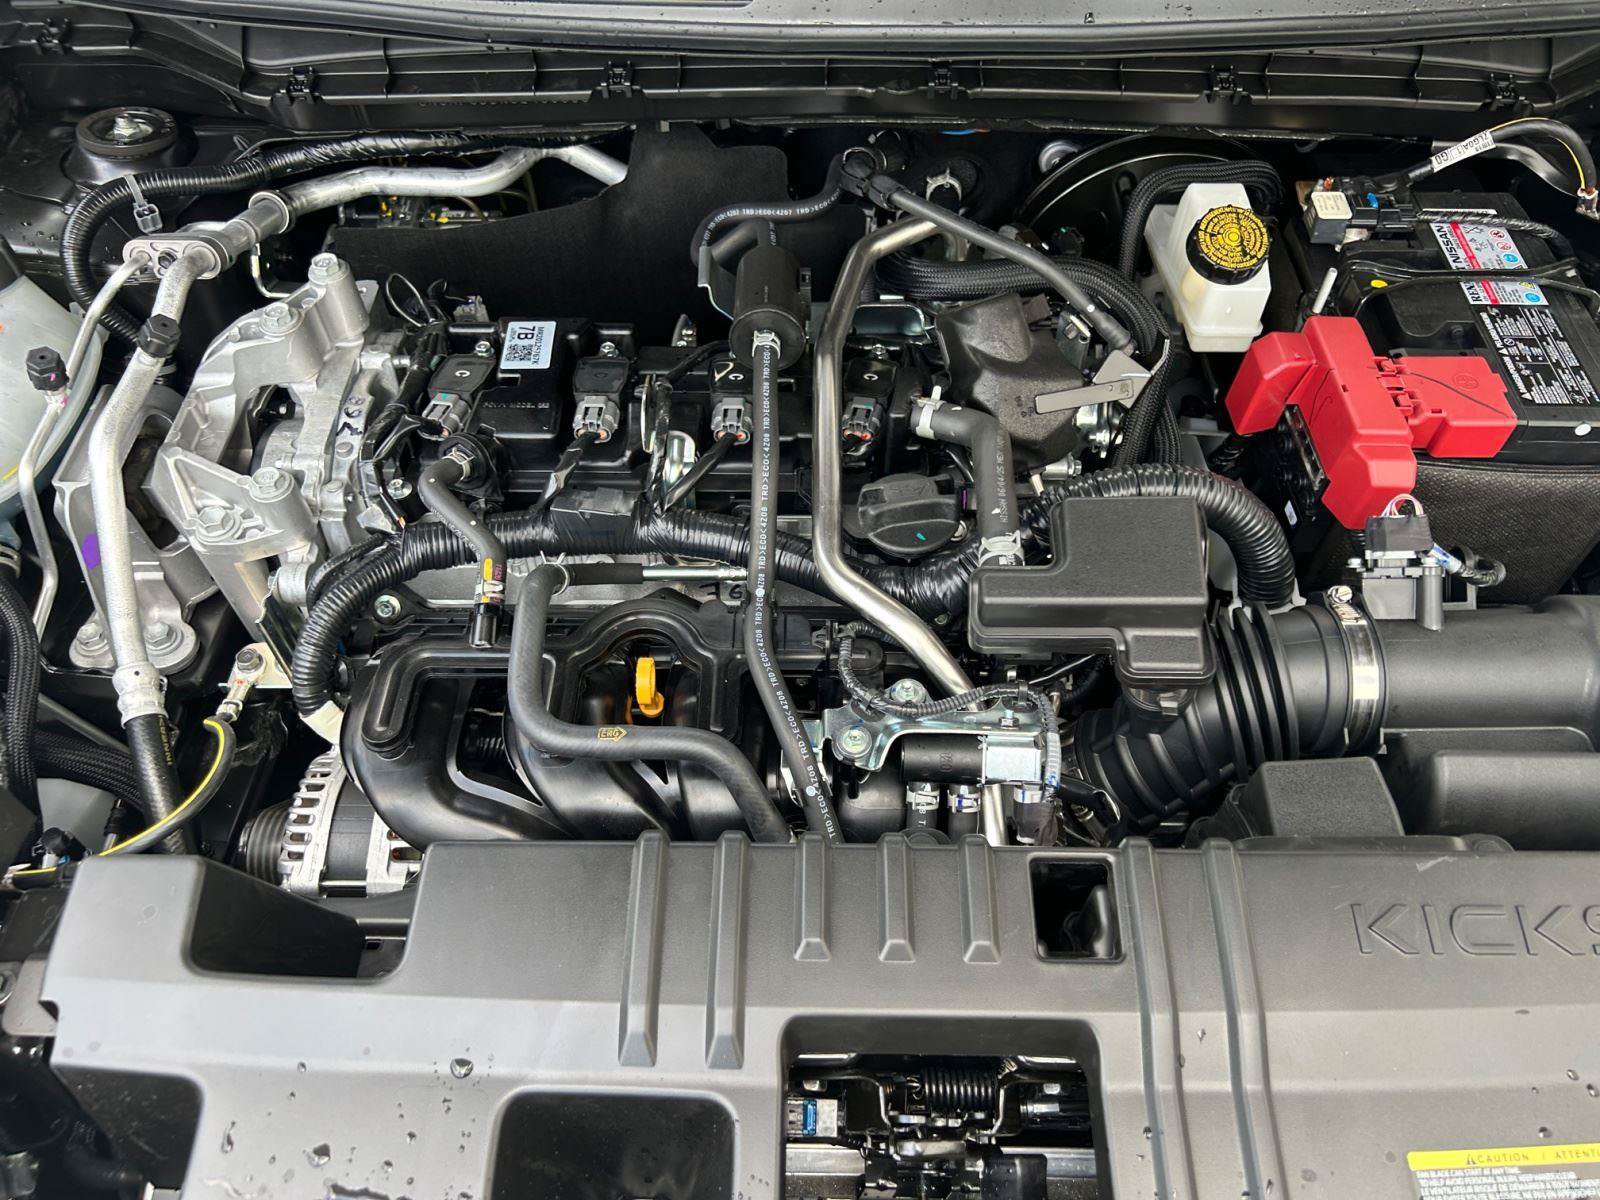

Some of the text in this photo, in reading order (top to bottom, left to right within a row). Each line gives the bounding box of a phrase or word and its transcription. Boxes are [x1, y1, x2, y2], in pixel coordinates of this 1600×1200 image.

[1435, 225, 1462, 264] NISSAN
[517, 326, 536, 340] 7B
[758, 506, 769, 570] TRD>ECO<4Z08
[755, 573, 765, 626] TRD>EC4Z08
[776, 690, 810, 761] TRD>ECO<4Z08
[1477, 1152, 1530, 1164] CAUTION
